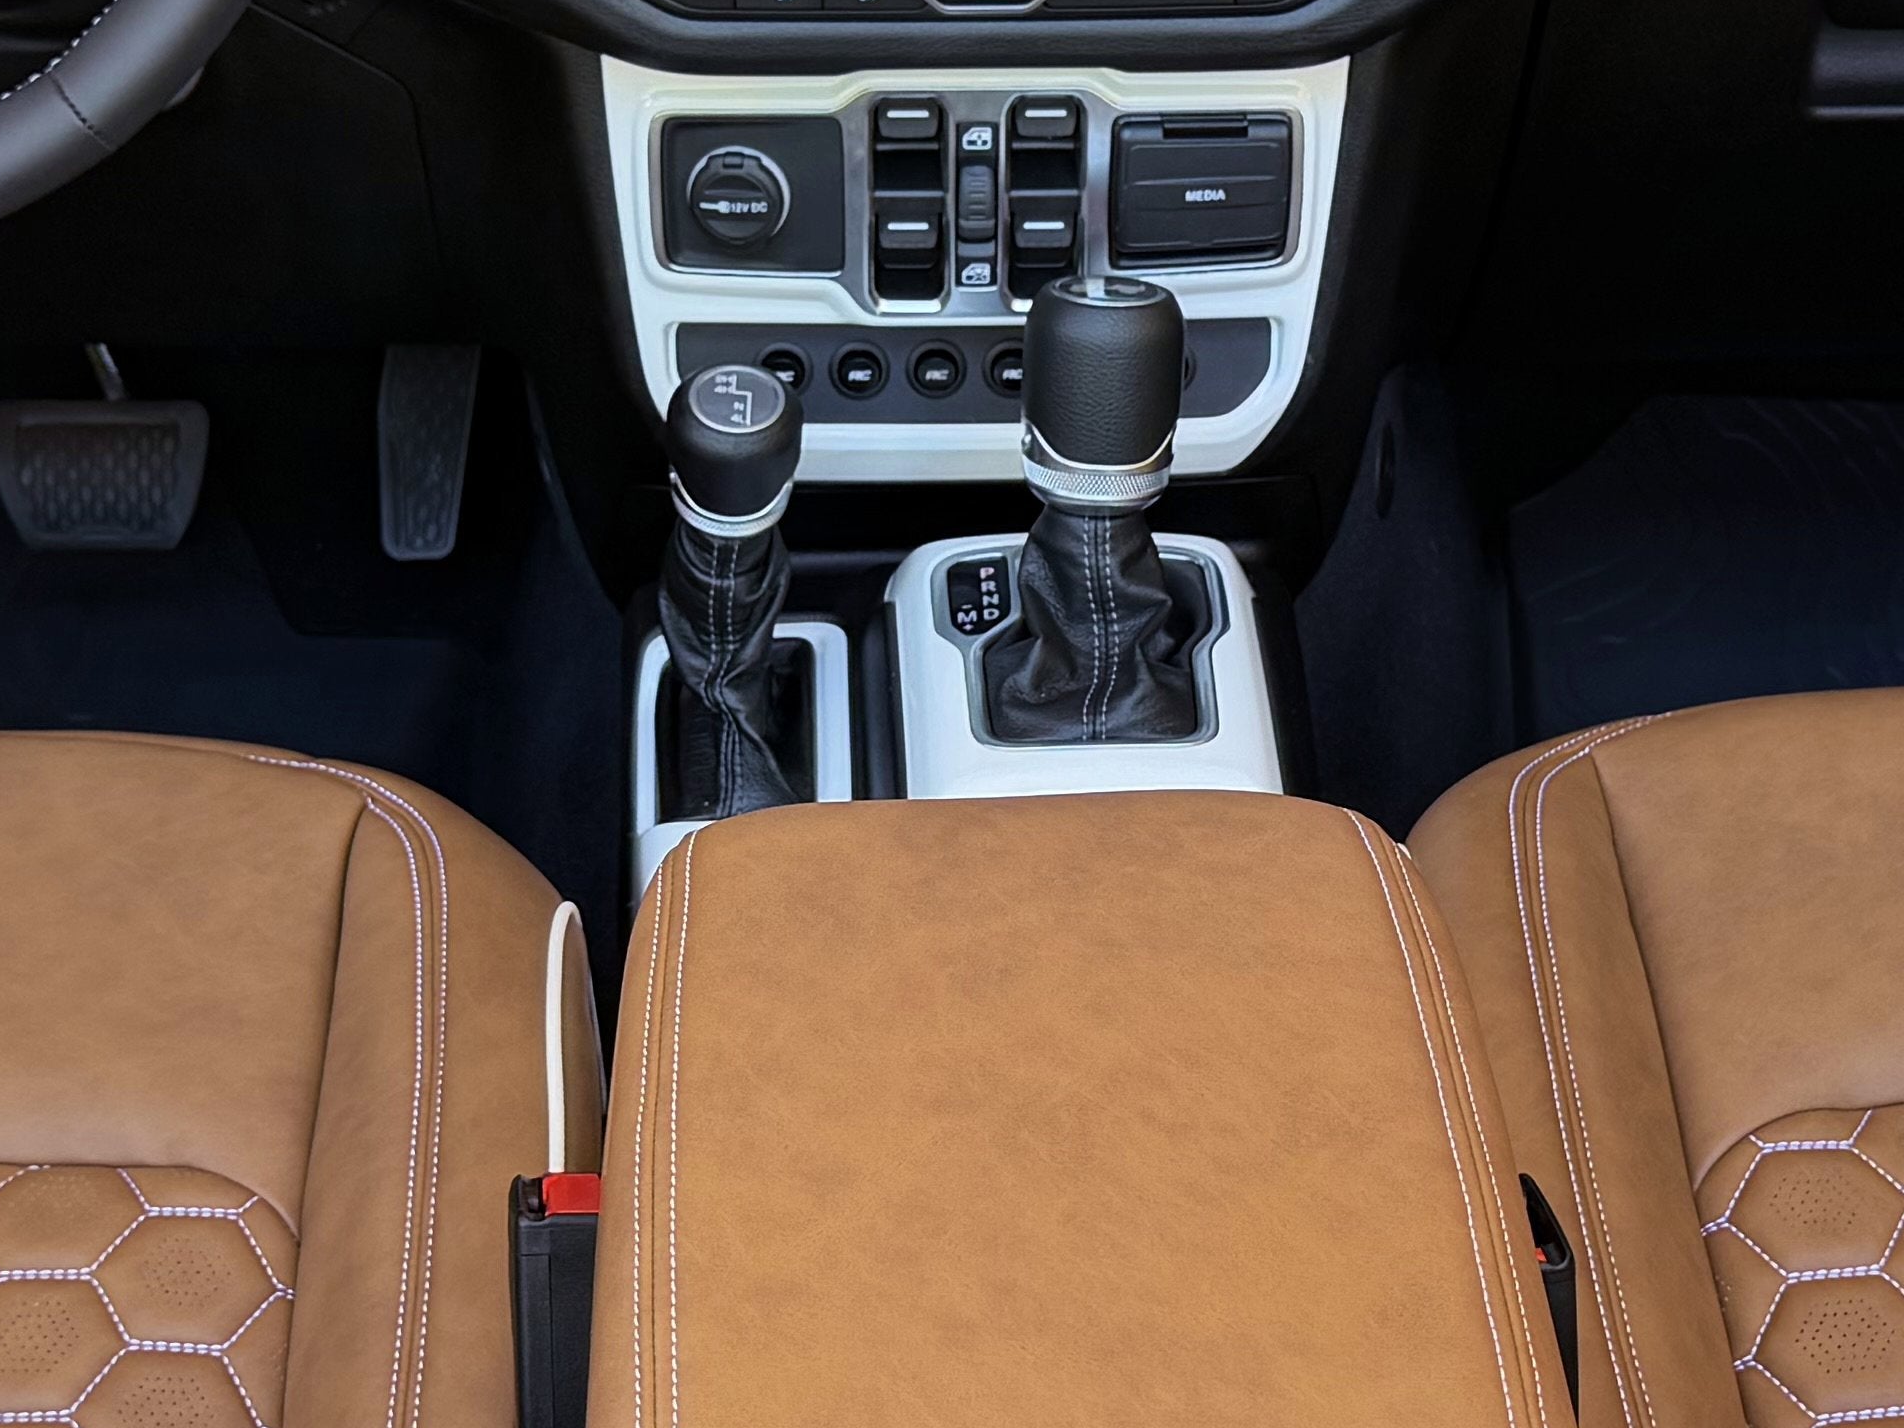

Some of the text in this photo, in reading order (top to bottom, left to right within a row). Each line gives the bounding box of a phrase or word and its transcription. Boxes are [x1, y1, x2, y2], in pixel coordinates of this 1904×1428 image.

[1185, 188, 1226, 202] MEDIA
[980, 566, 995, 580] P
[981, 581, 996, 593] R
[983, 593, 999, 606] N
[957, 610, 977, 623] M
[984, 608, 1000, 620] D
